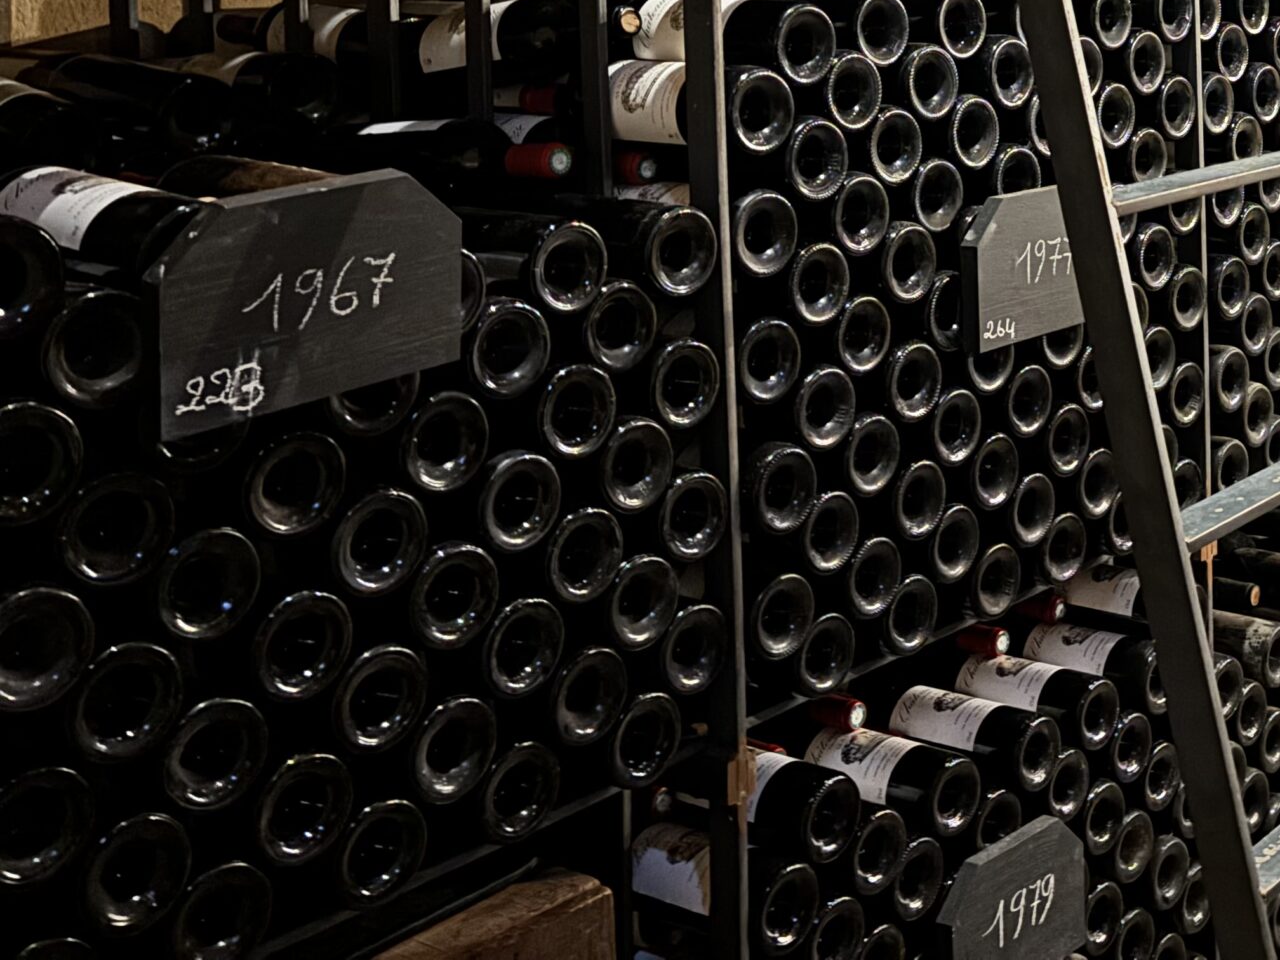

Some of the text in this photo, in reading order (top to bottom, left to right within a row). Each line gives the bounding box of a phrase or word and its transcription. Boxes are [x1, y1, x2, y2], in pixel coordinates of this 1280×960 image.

[242, 251, 397, 332] 1967
[983, 317, 1017, 340] 264
[981, 872, 1055, 949] 1979
